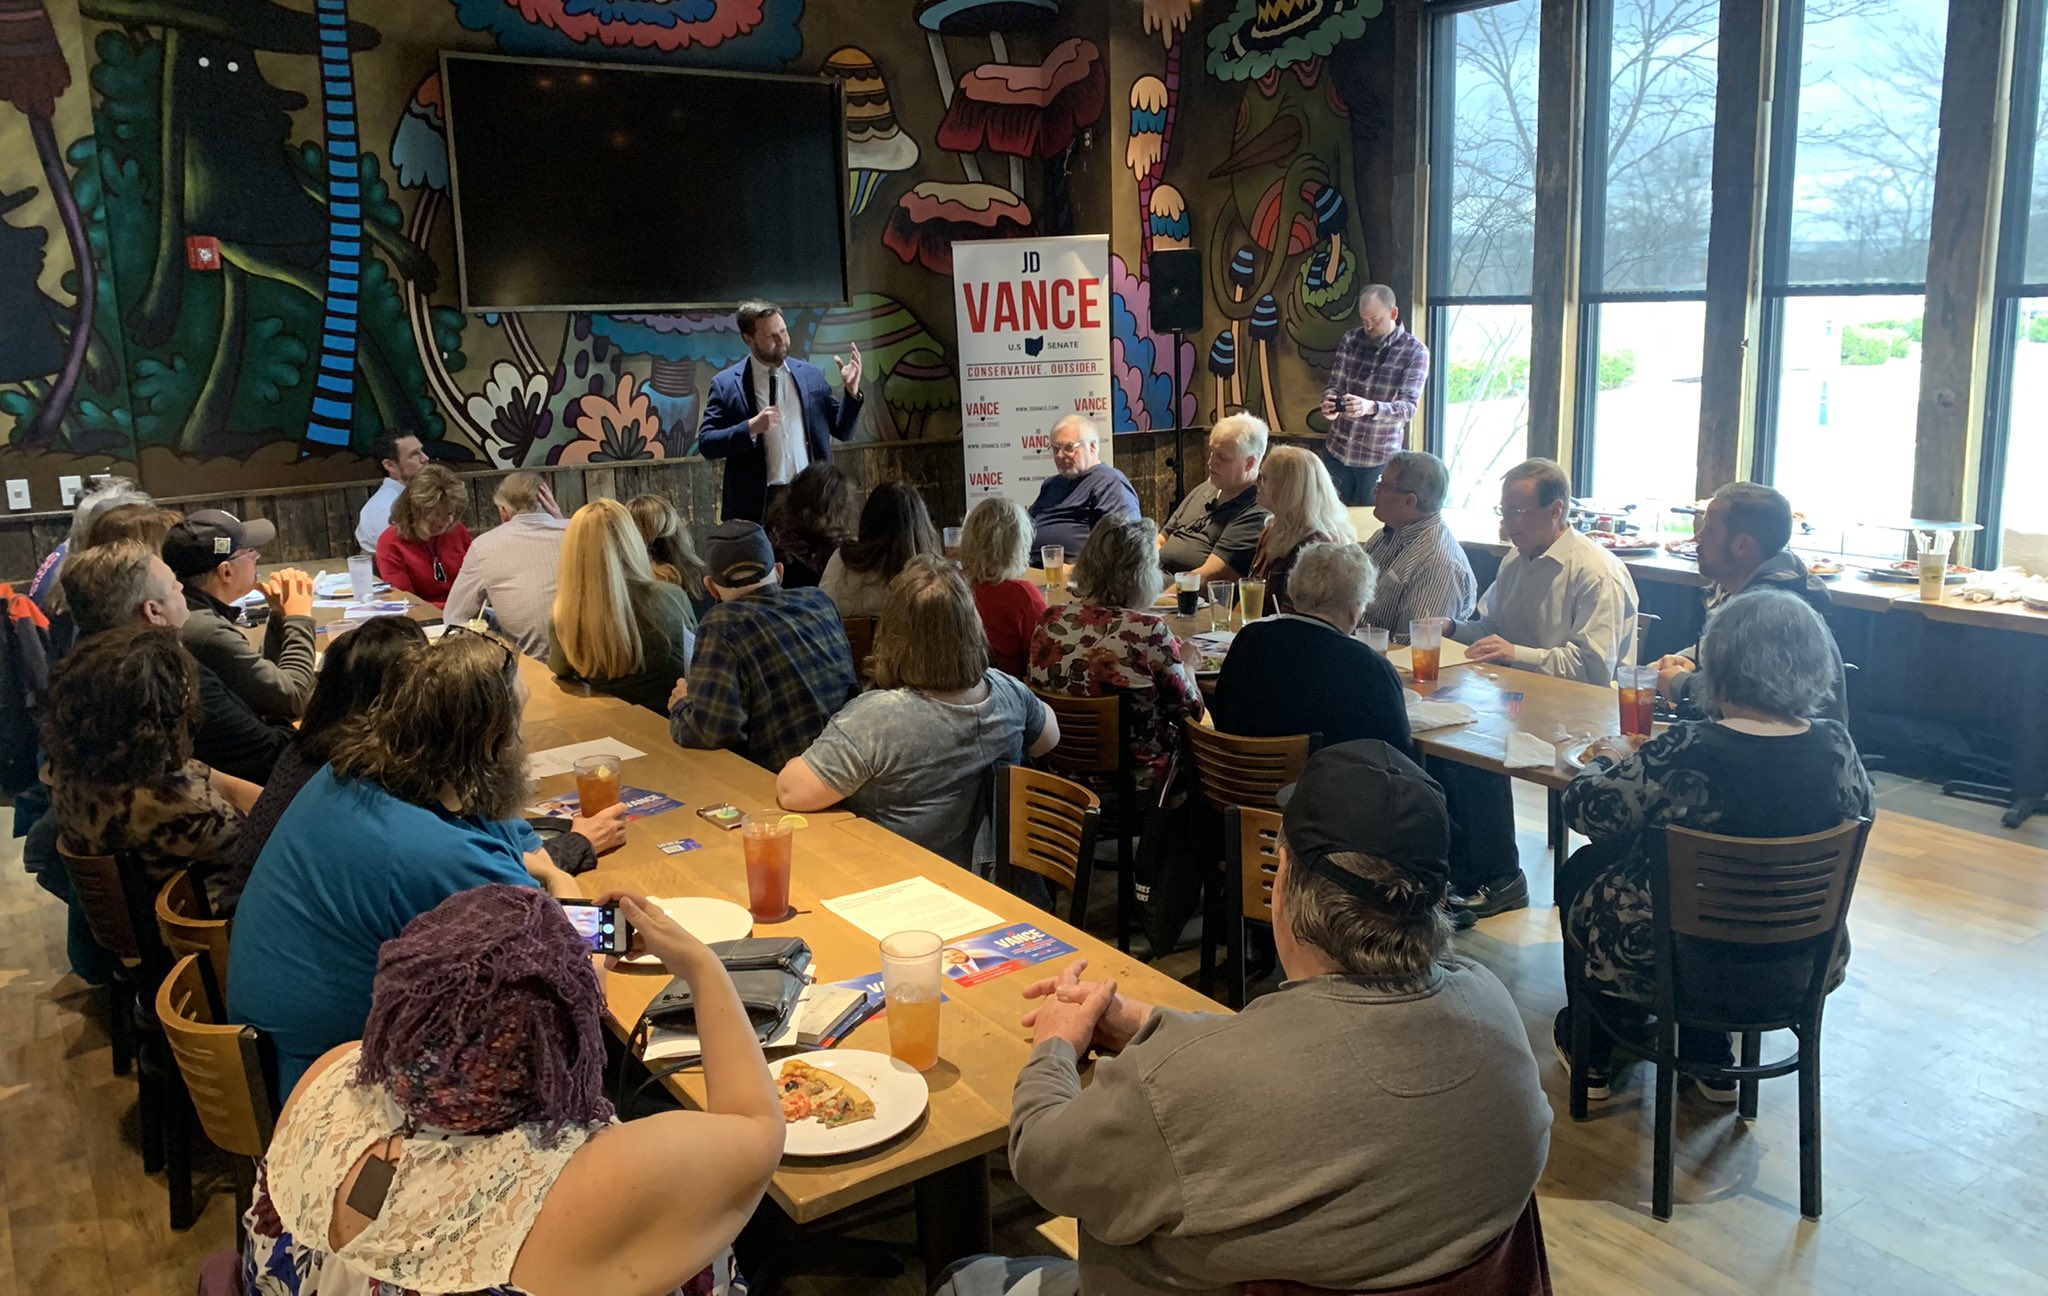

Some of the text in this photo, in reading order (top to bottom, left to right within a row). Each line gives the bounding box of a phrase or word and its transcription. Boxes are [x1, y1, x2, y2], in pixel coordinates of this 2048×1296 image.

[1021, 251, 1041, 273] JD
[962, 278, 1101, 333] VANCE
[1047, 341, 1079, 349] SENATE
[966, 402, 1000, 416] VANCE
[1074, 397, 1107, 411] VANCE
[1022, 435, 1050, 448] VANC
[969, 472, 1003, 486] VANCE
[993, 928, 1045, 949] VANCE
